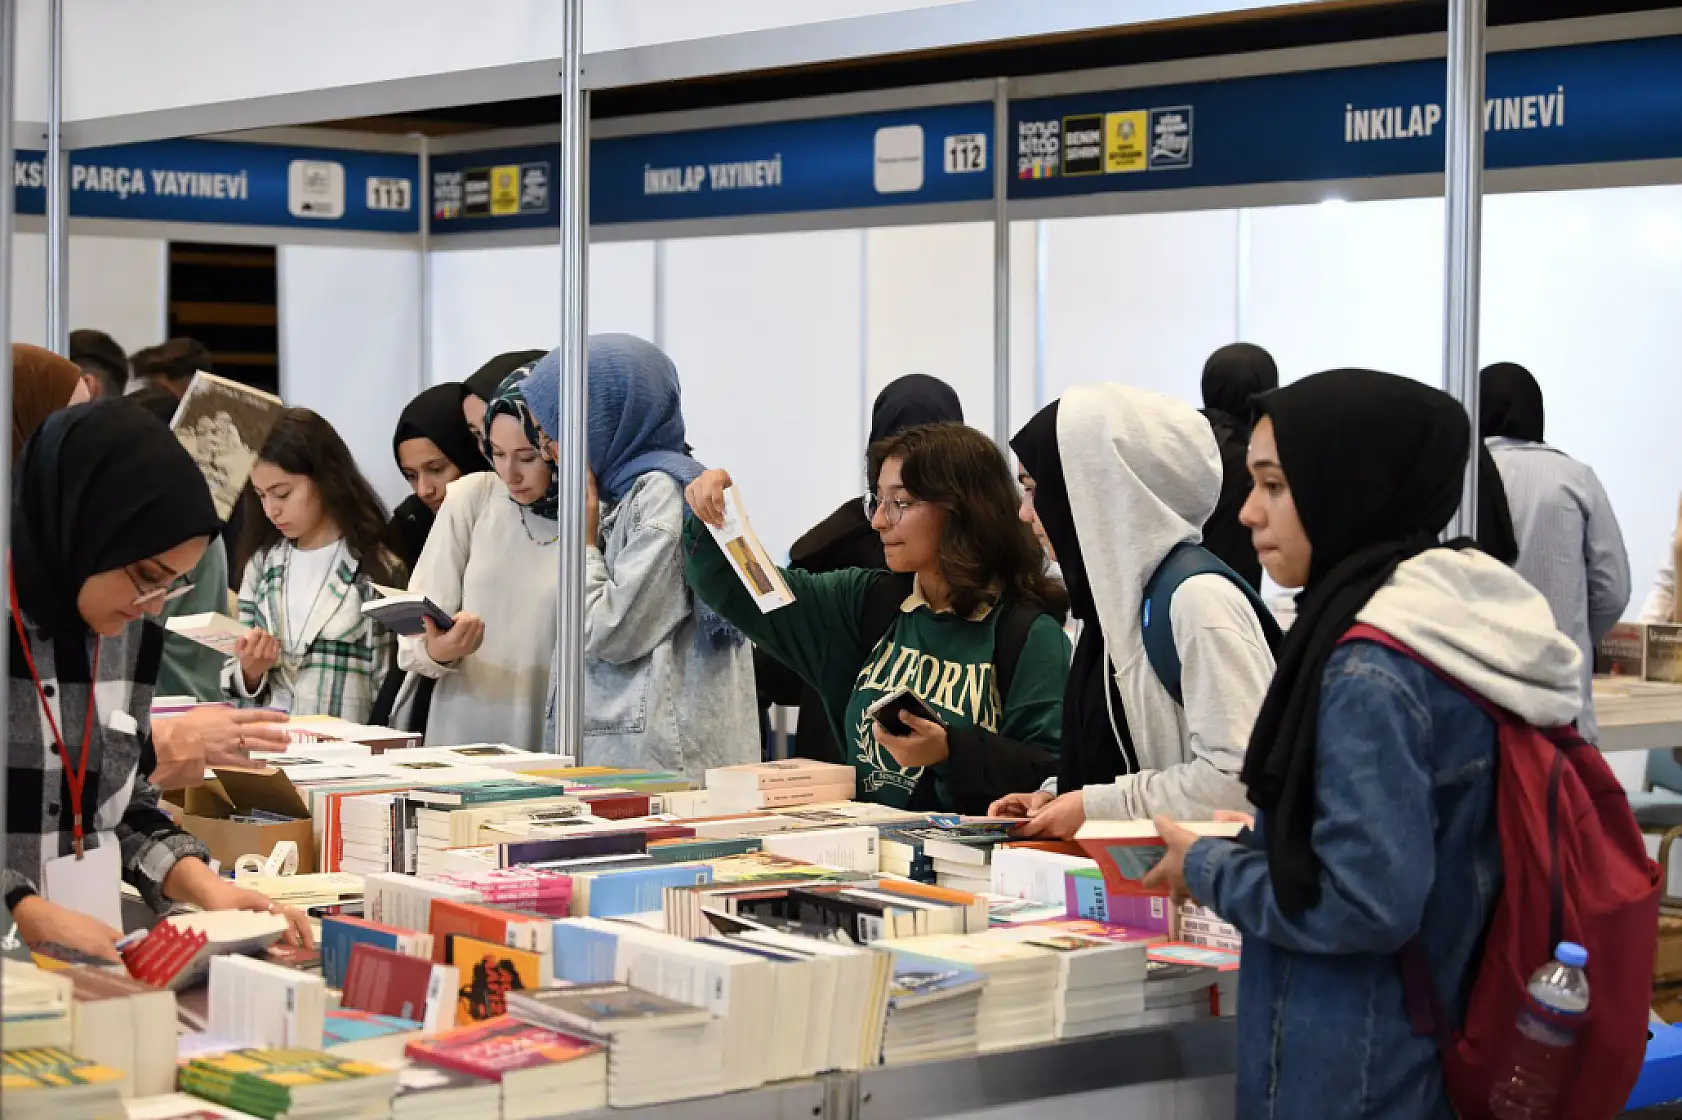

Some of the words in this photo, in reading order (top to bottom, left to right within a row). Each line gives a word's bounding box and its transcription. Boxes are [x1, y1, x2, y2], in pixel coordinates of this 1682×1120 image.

[1344, 103, 1442, 142] İNKILAP
[708, 153, 782, 191] YAYINEVİ
[950, 144, 981, 170] 112
[71, 164, 147, 200] PARÇA
[150, 168, 248, 200] YAYINEVİ
